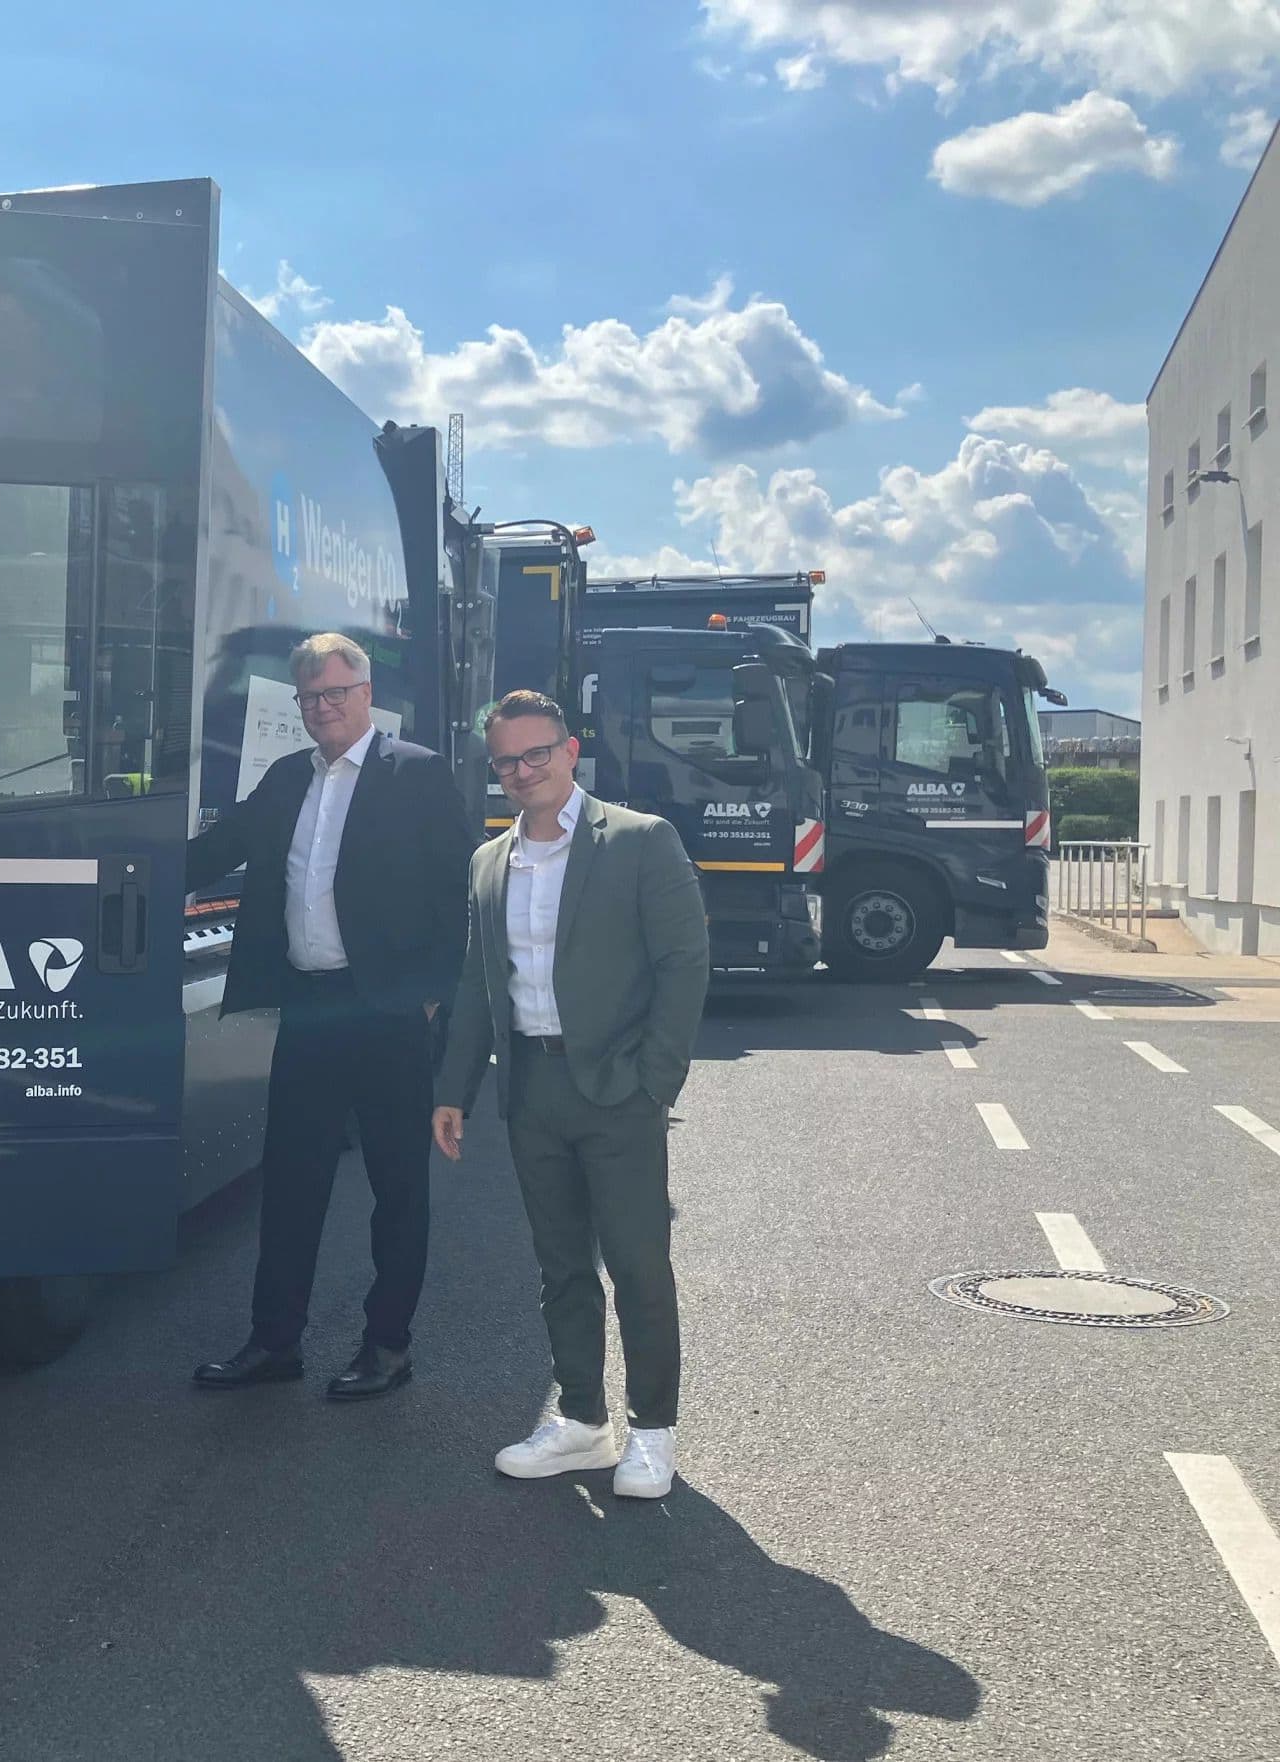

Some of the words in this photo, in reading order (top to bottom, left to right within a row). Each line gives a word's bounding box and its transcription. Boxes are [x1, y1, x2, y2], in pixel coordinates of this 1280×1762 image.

[300, 492, 371, 609] Weniger
[907, 783, 949, 796] ALBA
[703, 803, 751, 817] ALBA
[25, 1083, 82, 1098] alba.info
